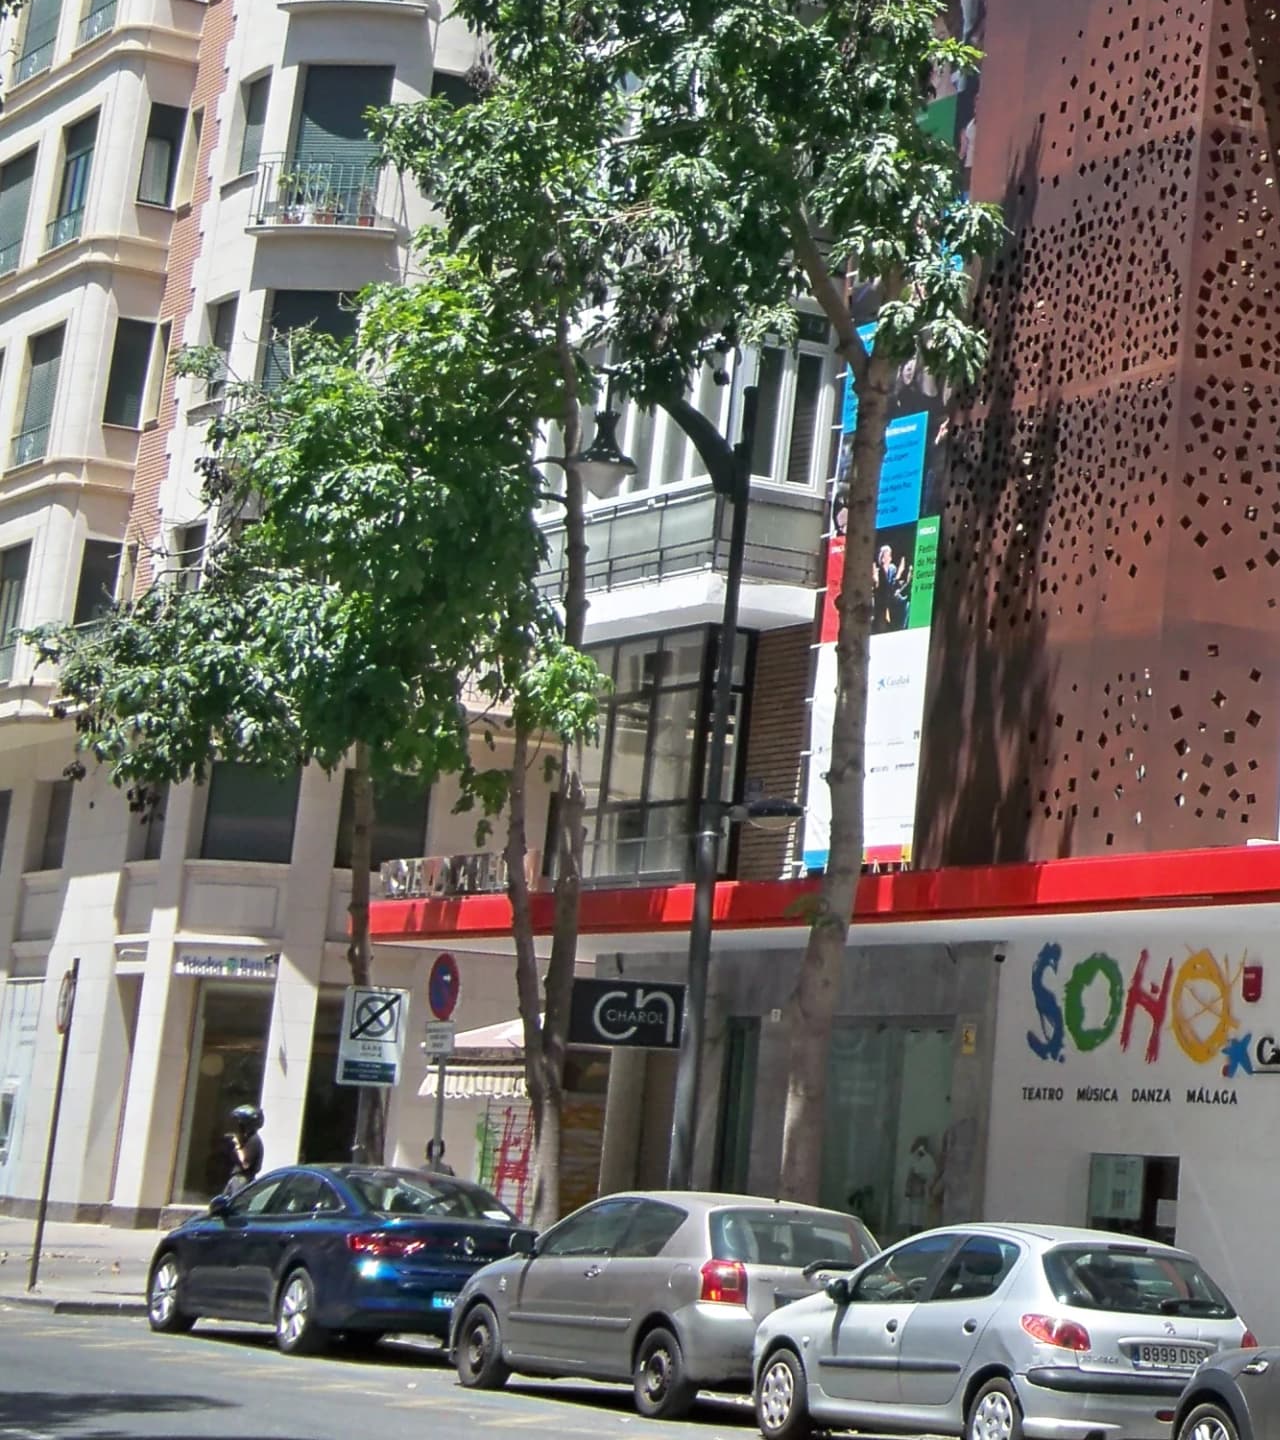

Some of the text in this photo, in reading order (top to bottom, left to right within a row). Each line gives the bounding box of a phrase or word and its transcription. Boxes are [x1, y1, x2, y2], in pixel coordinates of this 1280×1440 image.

[1026, 942, 1247, 1063] SOHO
[606, 1009, 665, 1025] CHAROL
[1022, 1084, 1238, 1105] TEATRO MÚSICA DANZA MÁLAGA
[1142, 1346, 1177, 1363] 8999
